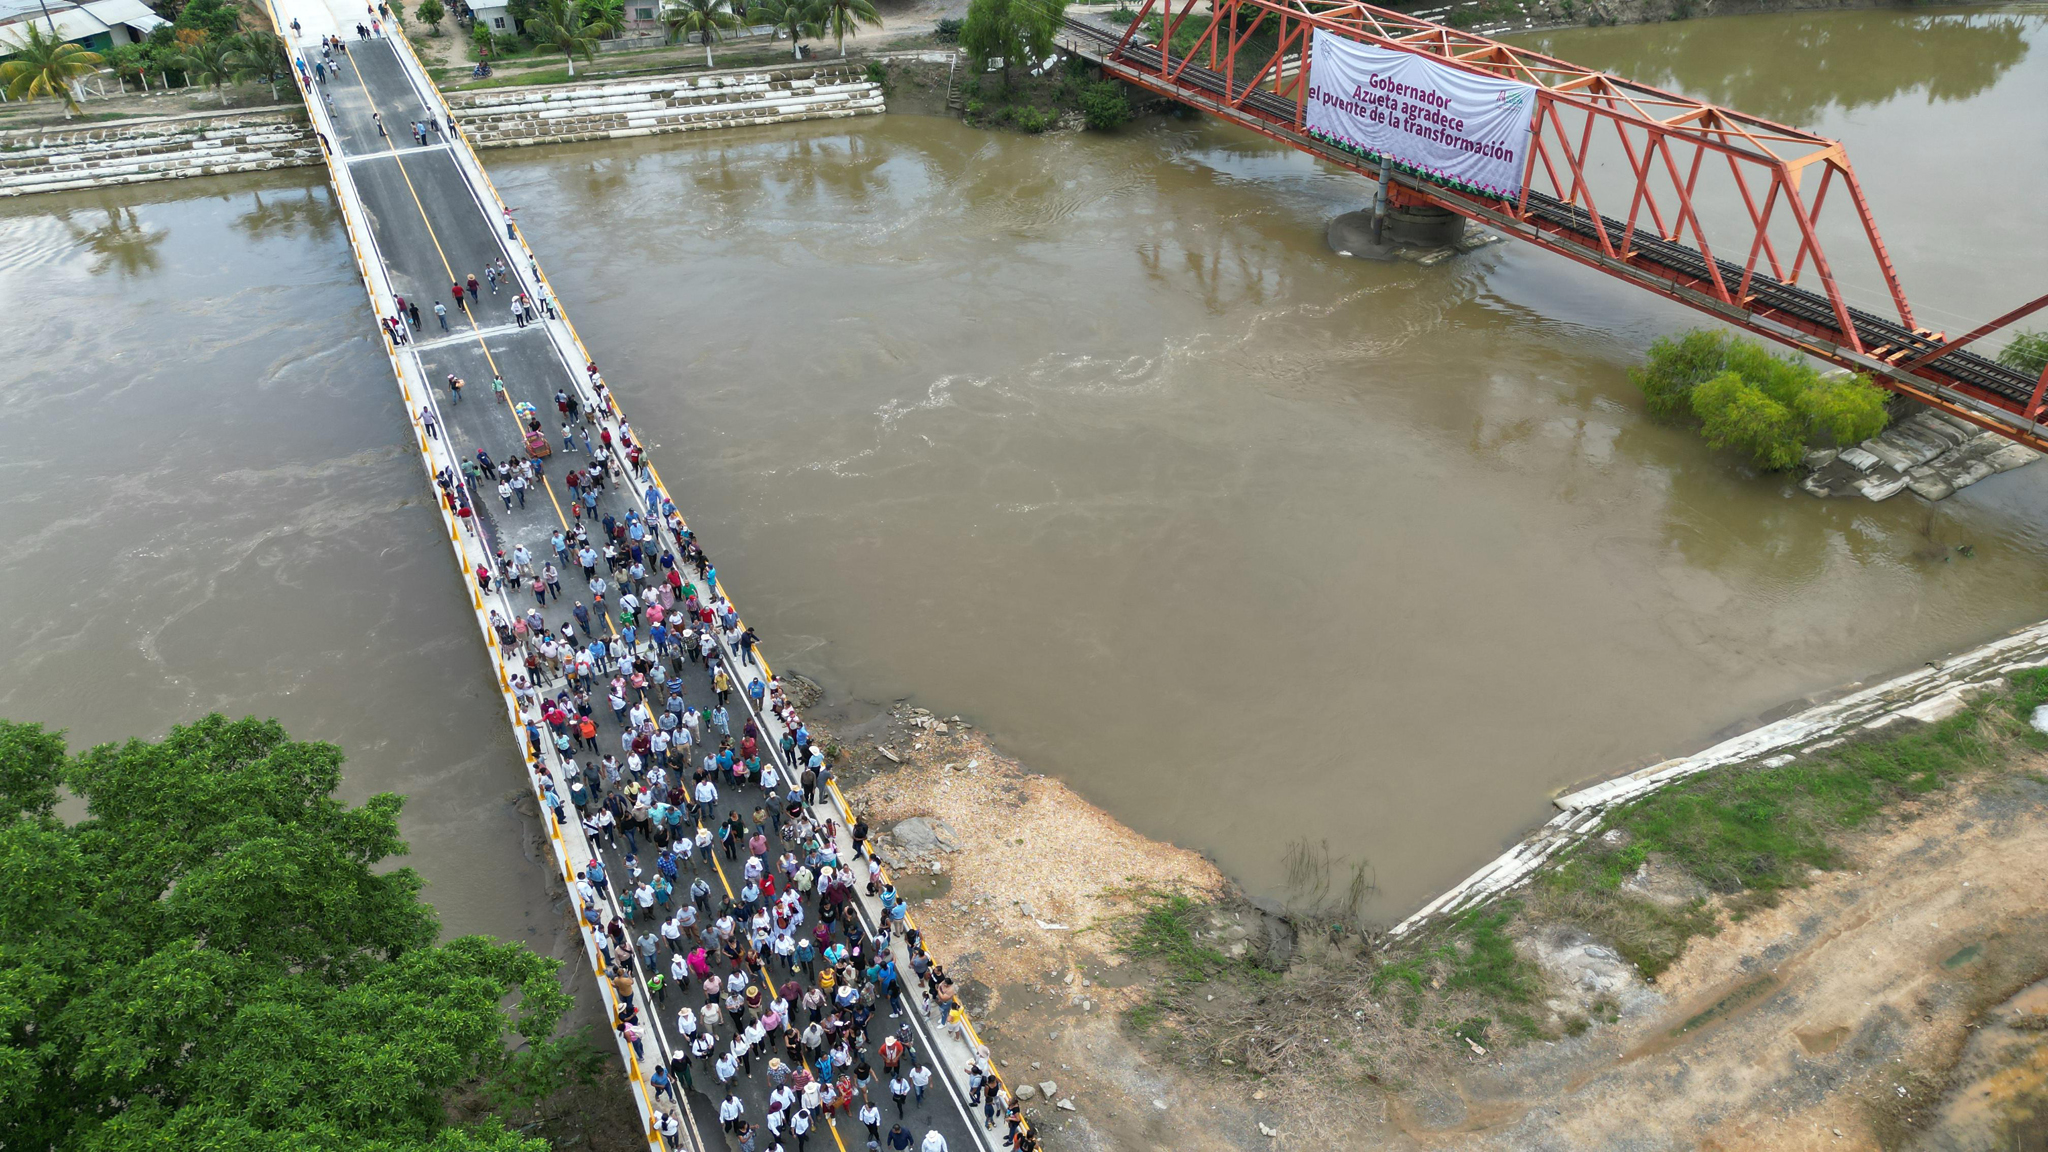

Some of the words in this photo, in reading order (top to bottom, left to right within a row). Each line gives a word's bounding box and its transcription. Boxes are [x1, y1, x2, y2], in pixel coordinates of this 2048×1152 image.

[1352, 85, 1398, 111] Azueta
[1401, 104, 1464, 133] agradece
[1369, 73, 1452, 110] Gobernador
[1308, 86, 1321, 101] el
[1323, 92, 1366, 118] puente
[1369, 105, 1385, 124] de
[1388, 111, 1400, 129] la
[1403, 120, 1514, 163] transformación
